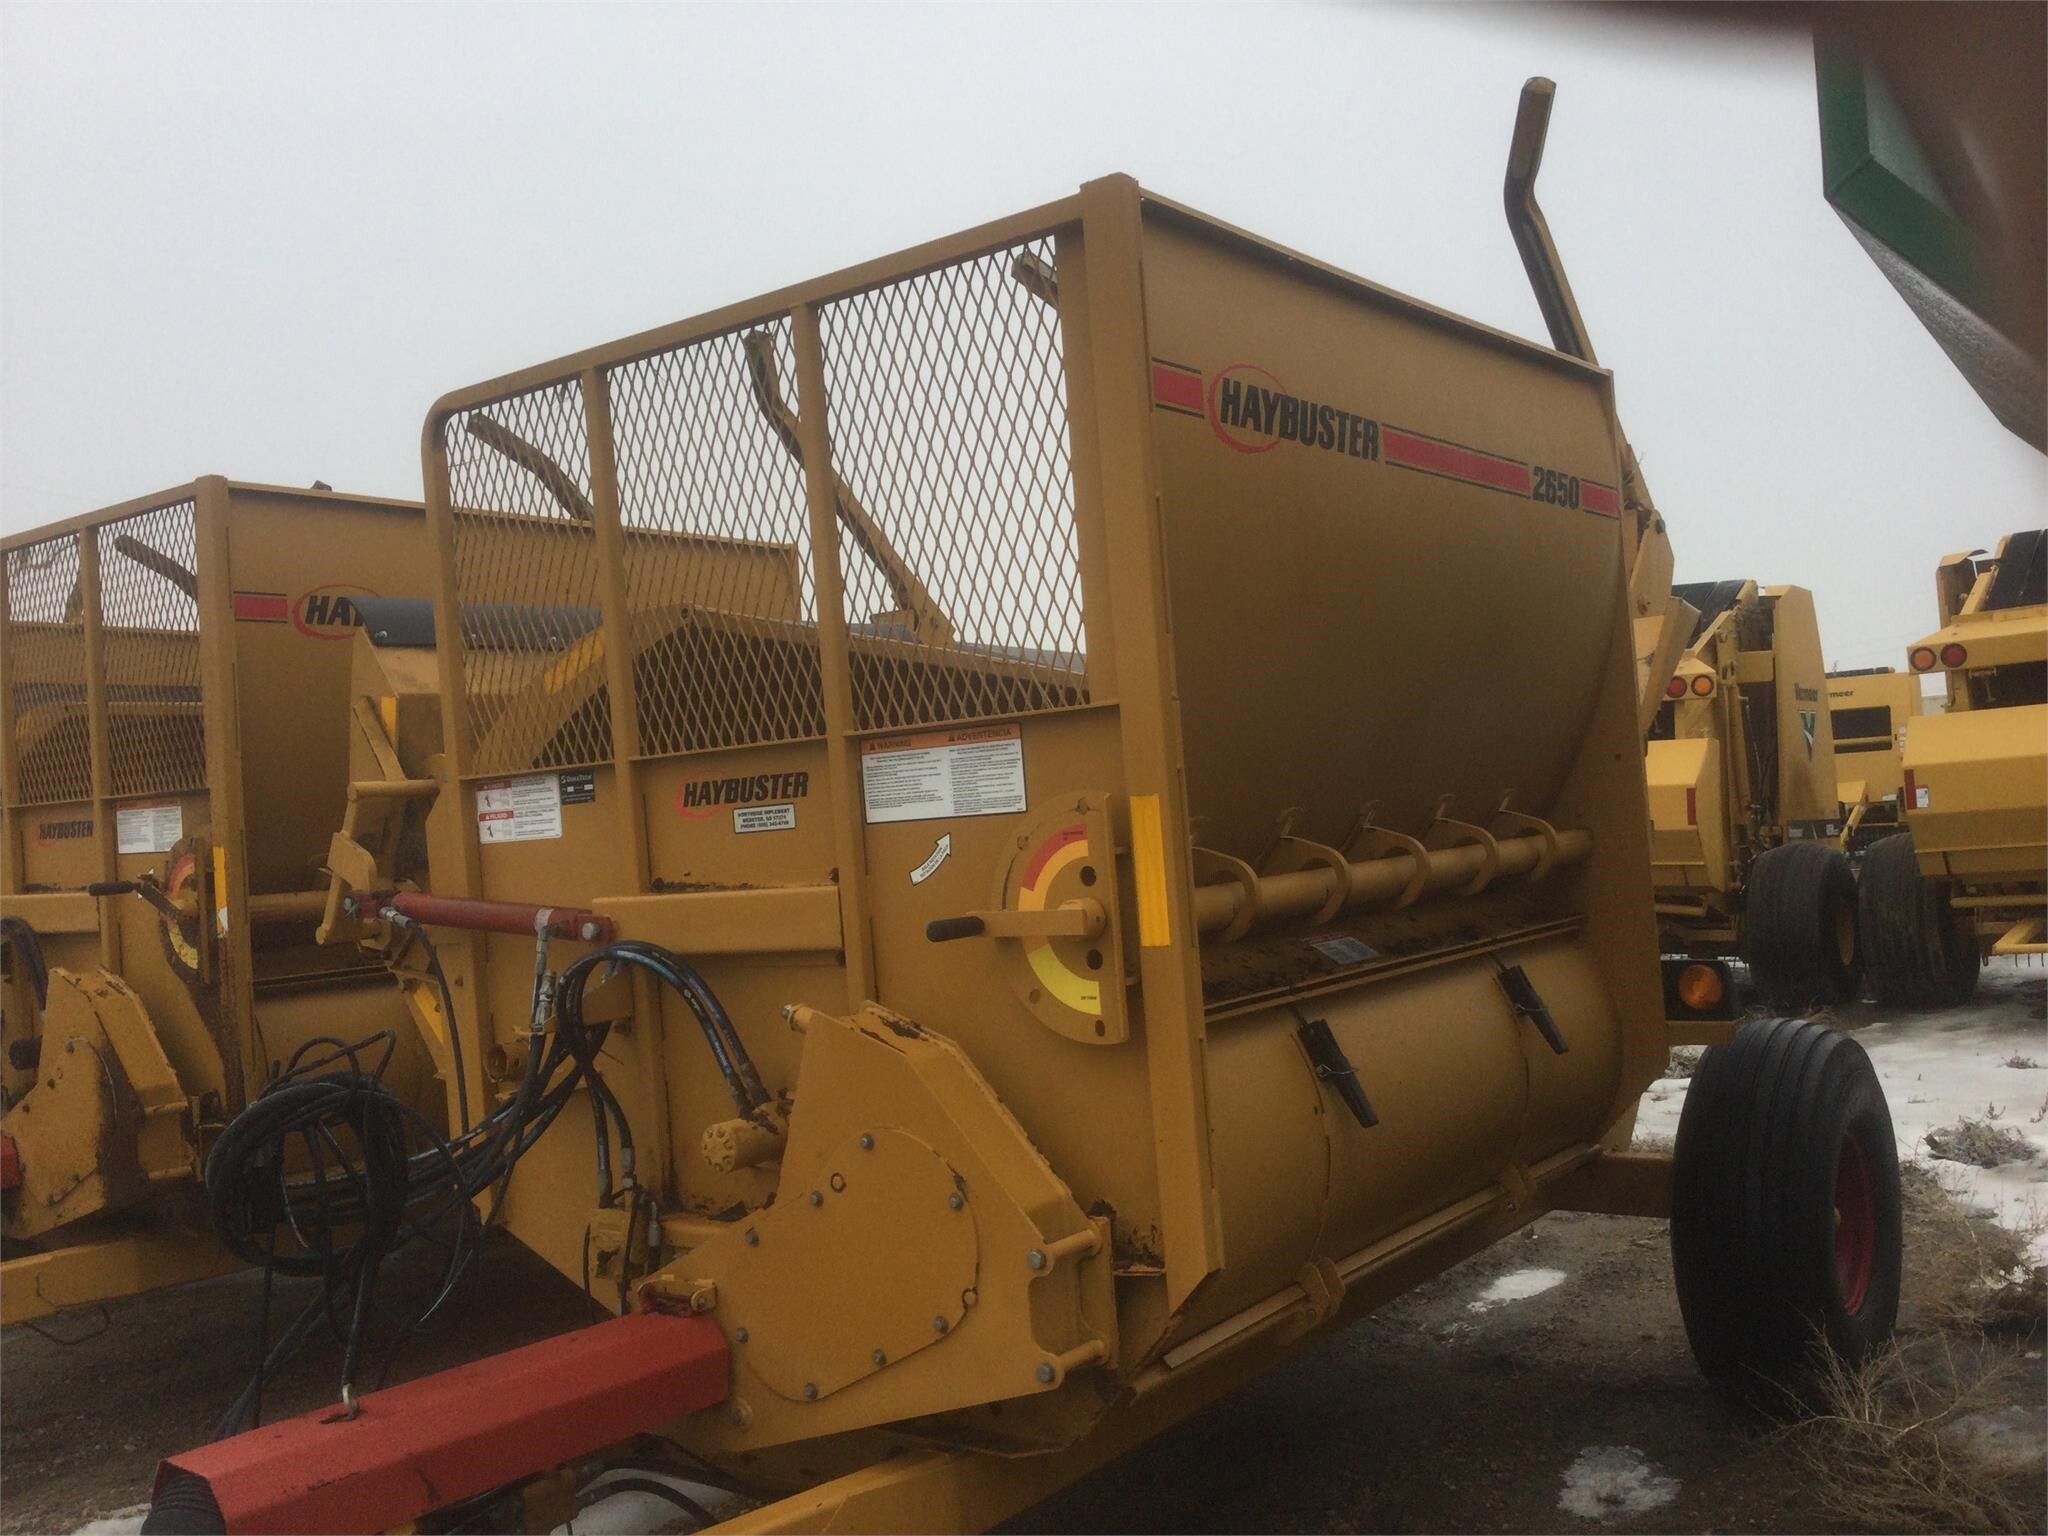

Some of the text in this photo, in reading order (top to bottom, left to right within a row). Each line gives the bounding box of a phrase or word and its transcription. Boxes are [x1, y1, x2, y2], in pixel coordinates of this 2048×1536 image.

[1220, 377, 1379, 461] HAYBUSTER
[1532, 465, 1581, 510] 2650
[683, 771, 809, 807] HAYBUSTER
[39, 819, 94, 840] HAYBUSTER
